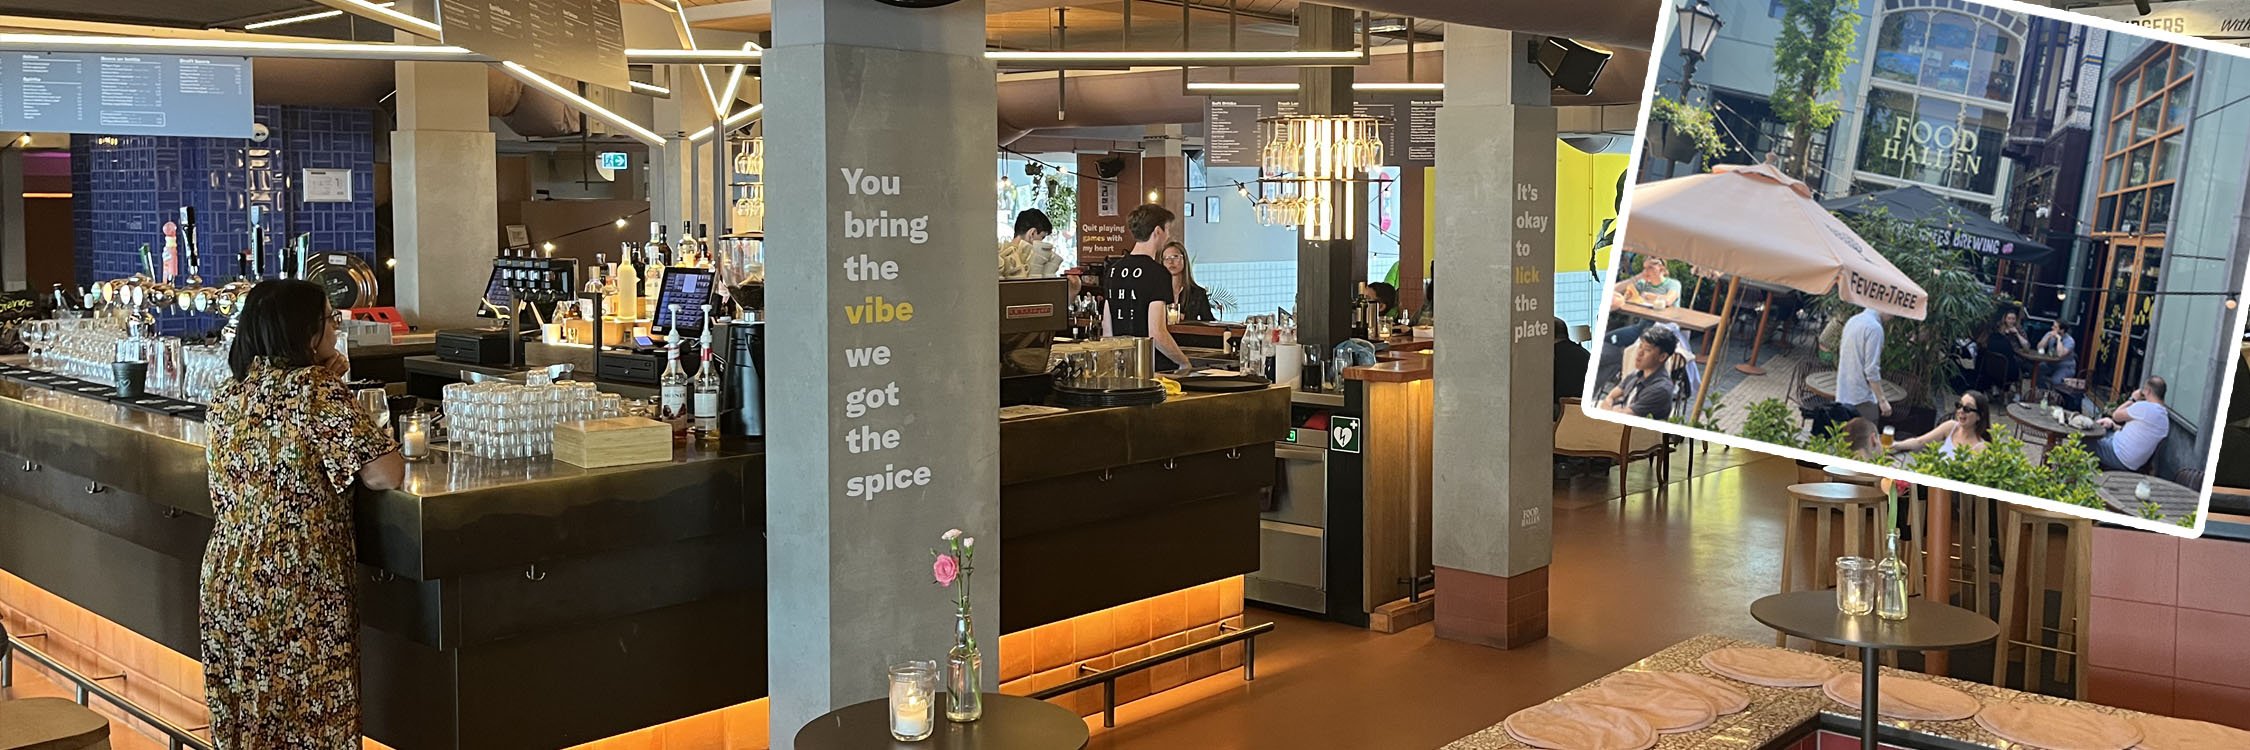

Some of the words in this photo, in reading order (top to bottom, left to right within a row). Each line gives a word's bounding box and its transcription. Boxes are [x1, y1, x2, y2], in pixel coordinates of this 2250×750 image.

[1893, 116, 1979, 153] FOOD
[1882, 138, 1982, 175] HALLEN
[841, 168, 900, 196] You
[1517, 183, 1538, 201] It's
[844, 210, 929, 244] bring
[1082, 224, 1098, 233] Quit
[1098, 224, 1126, 234] playing
[1516, 211, 1548, 233] okay
[1082, 245, 1093, 253] my
[1094, 244, 1114, 252] heart
[1515, 240, 1530, 257] to
[1952, 230, 2000, 254] BREWING
[844, 254, 899, 281] the
[1515, 265, 1540, 285] lick
[1515, 293, 1538, 312] the
[1850, 271, 1918, 310] FEVER-TREE
[845, 296, 914, 325] vibe
[1514, 319, 1549, 343] plate
[845, 345, 891, 368] we
[846, 381, 900, 418] got
[845, 425, 900, 454] the
[846, 463, 932, 501] spice
